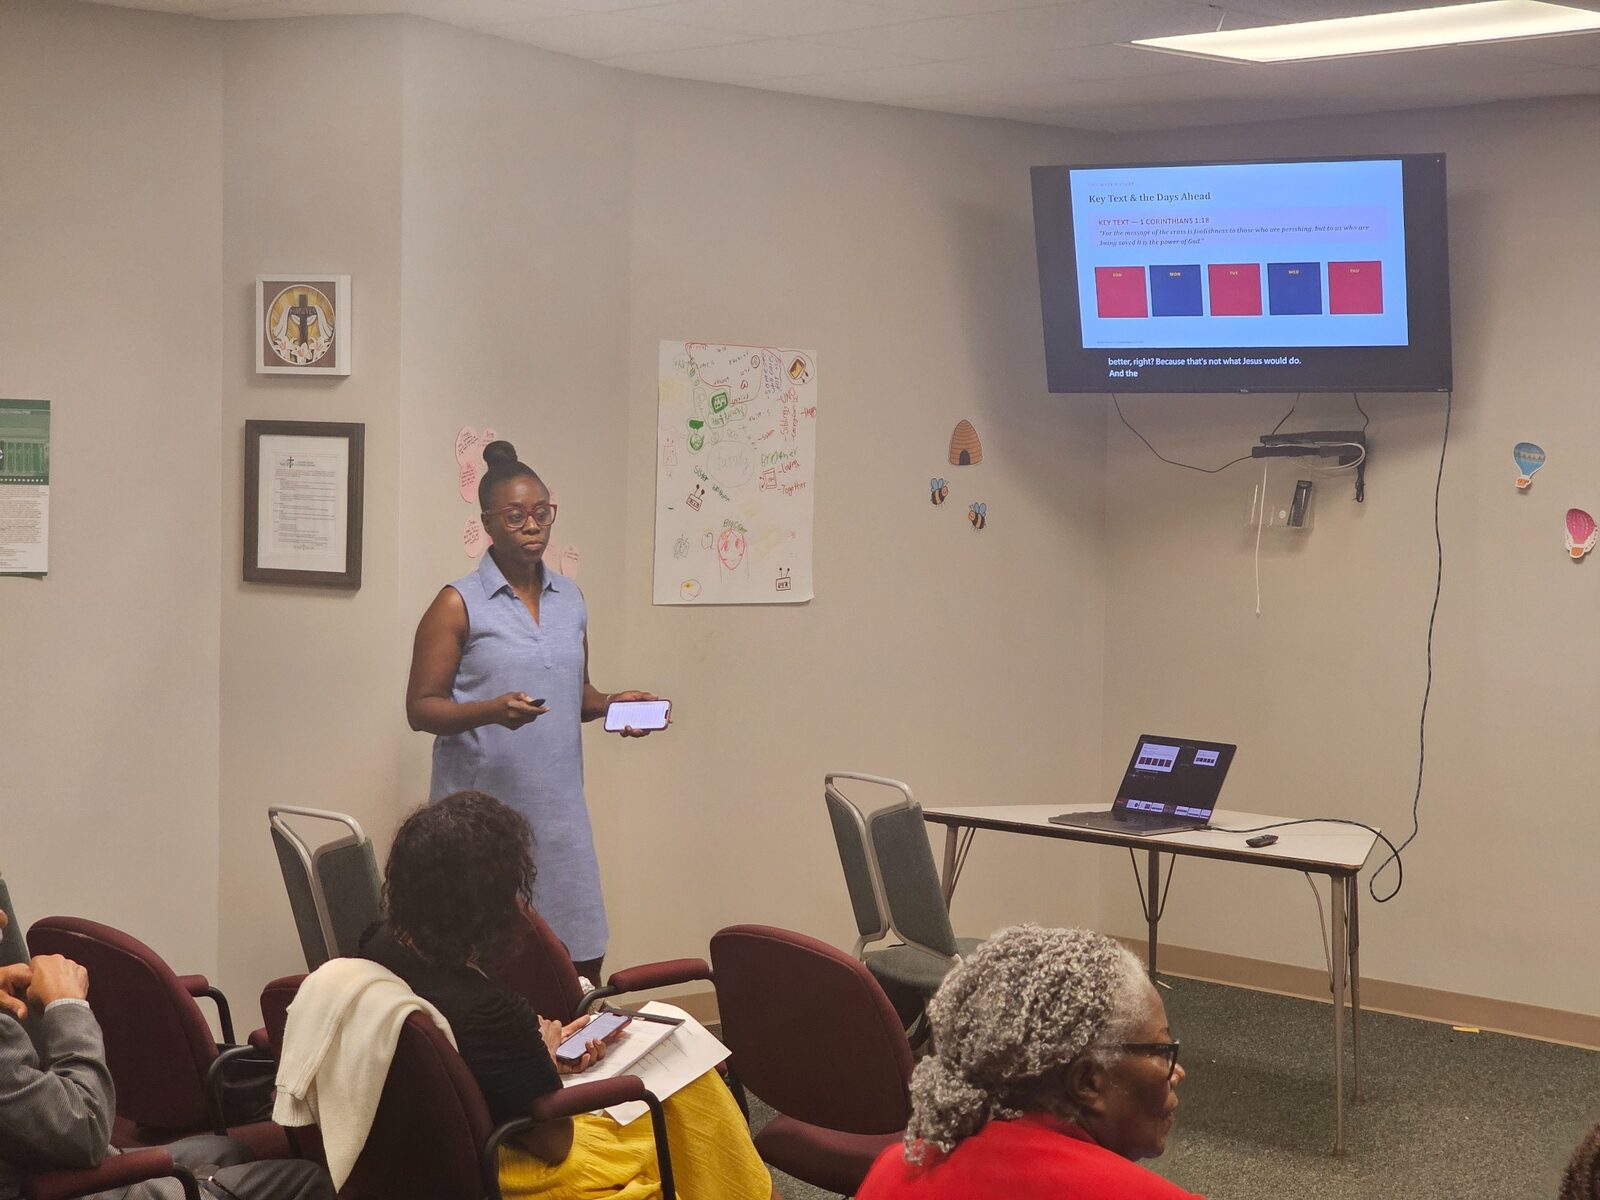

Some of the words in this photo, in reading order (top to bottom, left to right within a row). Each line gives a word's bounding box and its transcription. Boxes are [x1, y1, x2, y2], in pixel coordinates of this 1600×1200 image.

[1088, 194, 1106, 205] Key
[1108, 194, 1128, 203] Text
[1130, 194, 1137, 202] &
[1139, 193, 1155, 202] the
[1156, 193, 1179, 203] Days
[1180, 192, 1211, 201] Ahead
[1281, 225, 1313, 234] perishing,
[1108, 358, 1133, 366] better,
[1134, 357, 1154, 367] right?
